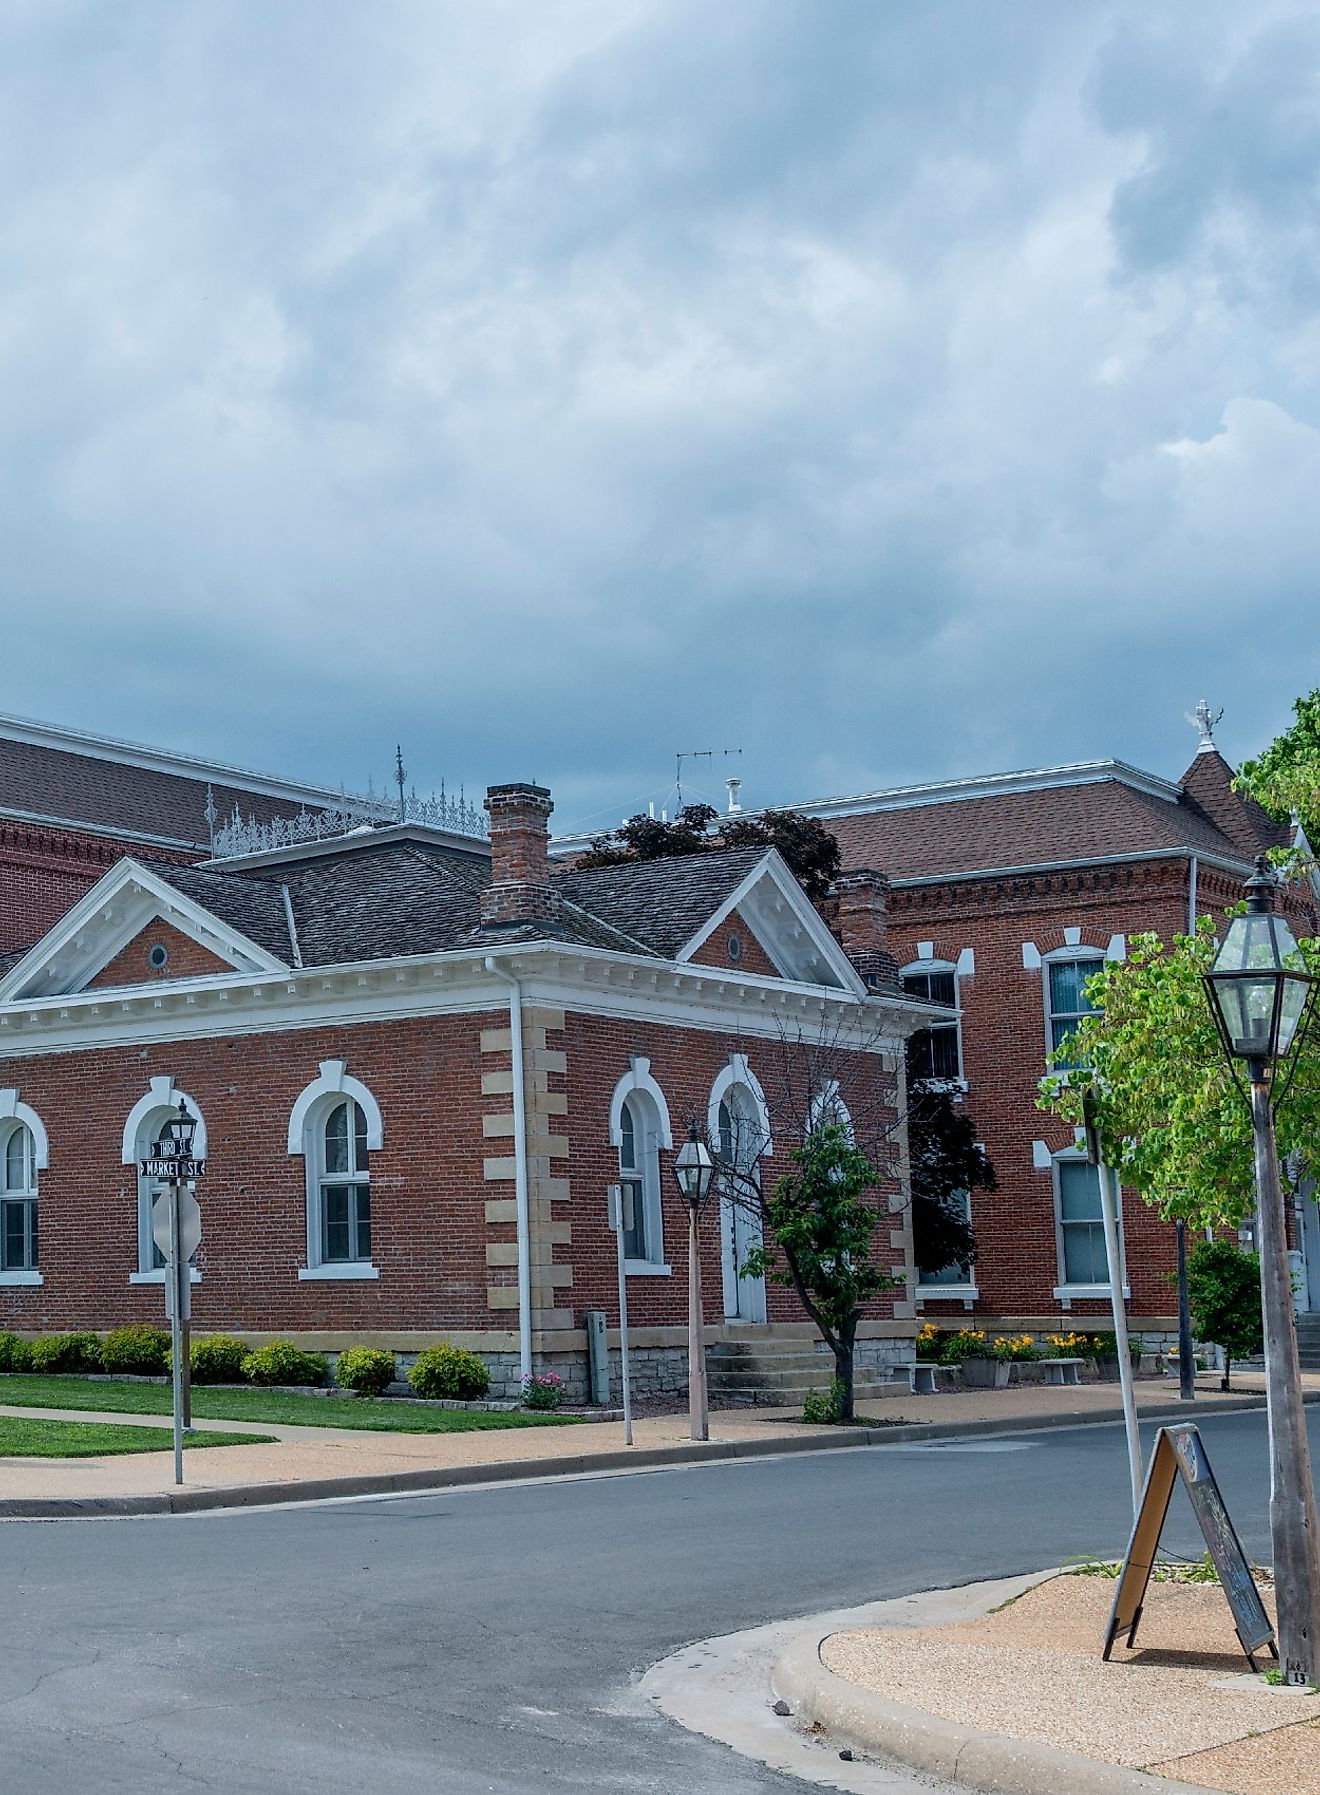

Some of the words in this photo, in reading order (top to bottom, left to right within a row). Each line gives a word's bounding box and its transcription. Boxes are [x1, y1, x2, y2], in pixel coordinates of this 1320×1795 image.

[159, 1142, 176, 1157] THIRD
[146, 1161, 179, 1176] MARKET
[187, 1162, 200, 1176] ST.
[1294, 1672, 1306, 1685] 13
